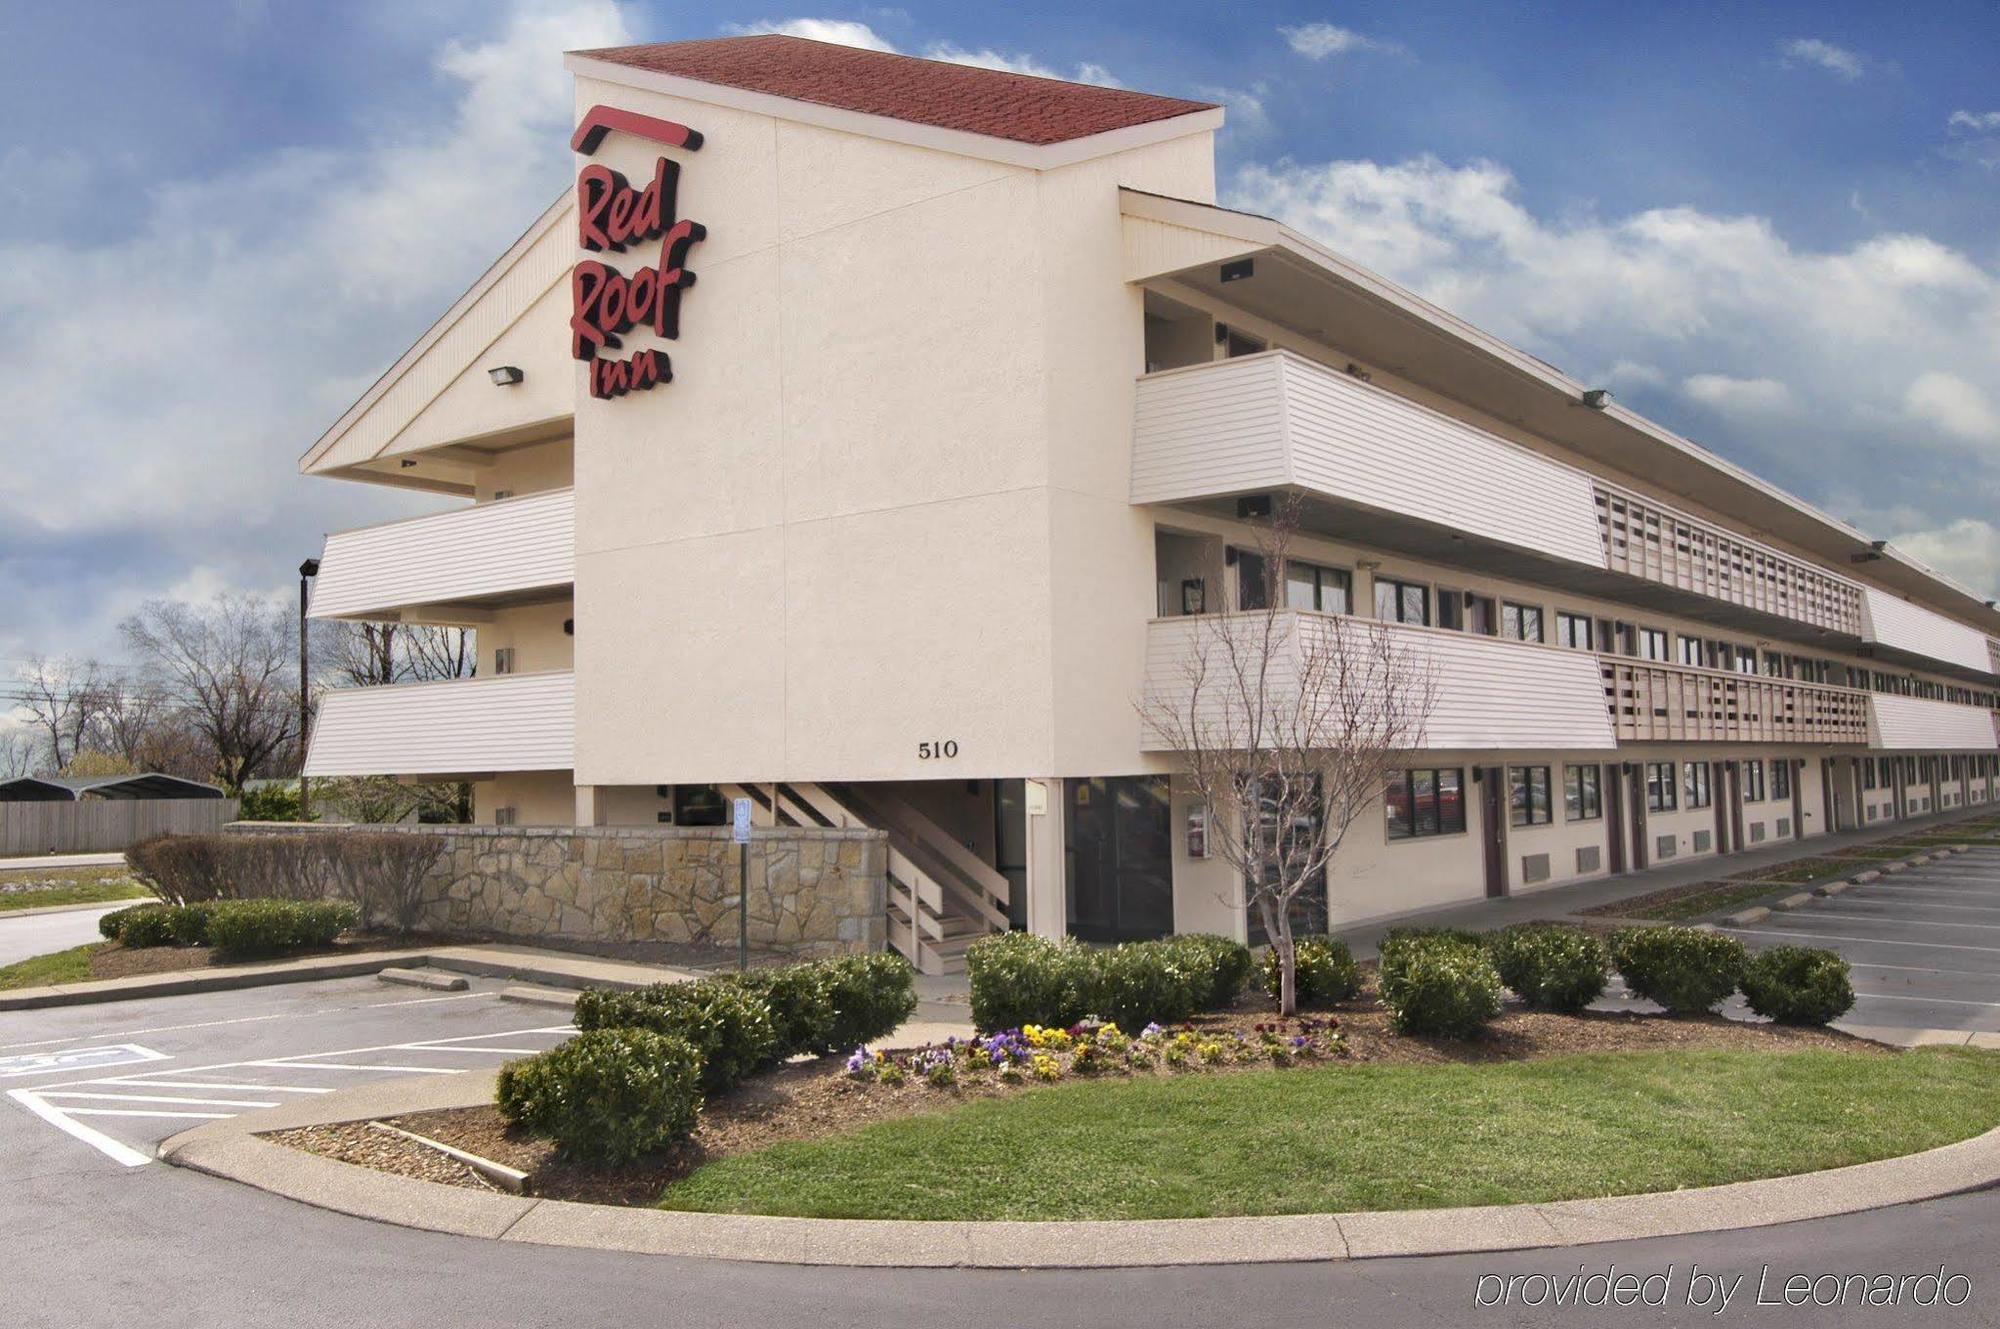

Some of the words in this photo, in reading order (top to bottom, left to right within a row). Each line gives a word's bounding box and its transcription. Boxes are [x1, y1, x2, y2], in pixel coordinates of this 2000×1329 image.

[577, 156, 680, 253] Red
[570, 219, 707, 361] Roof
[918, 740, 959, 760] 510
